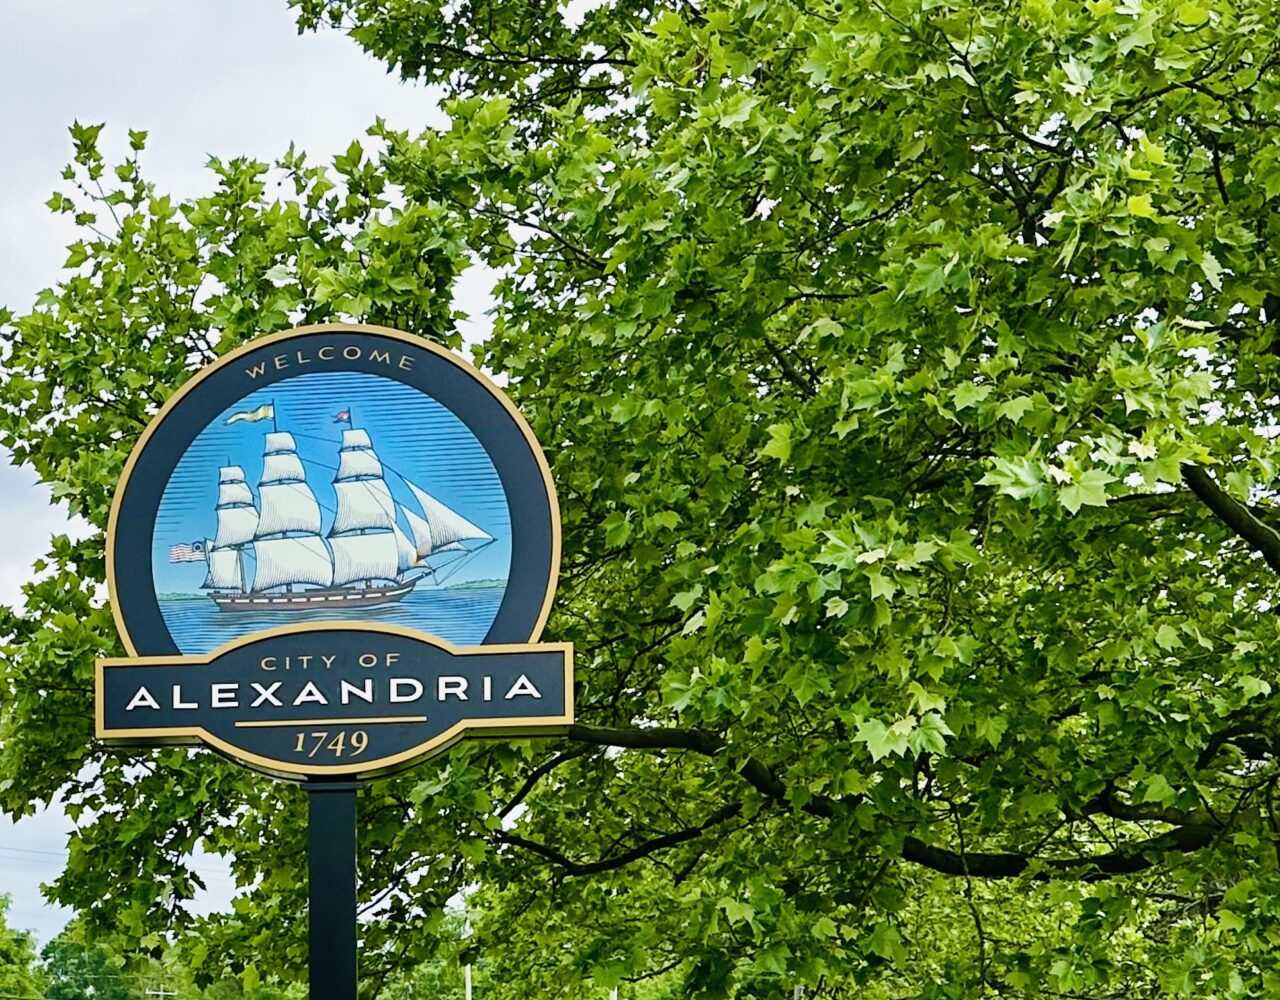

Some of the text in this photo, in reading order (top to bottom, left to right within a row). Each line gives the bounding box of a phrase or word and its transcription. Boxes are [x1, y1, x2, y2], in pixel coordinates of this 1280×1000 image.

[245, 346, 415, 379] WELCOME
[261, 653, 401, 671] CITY OF
[125, 674, 542, 711] ALEXANDRIA
[293, 730, 369, 757] 1749
